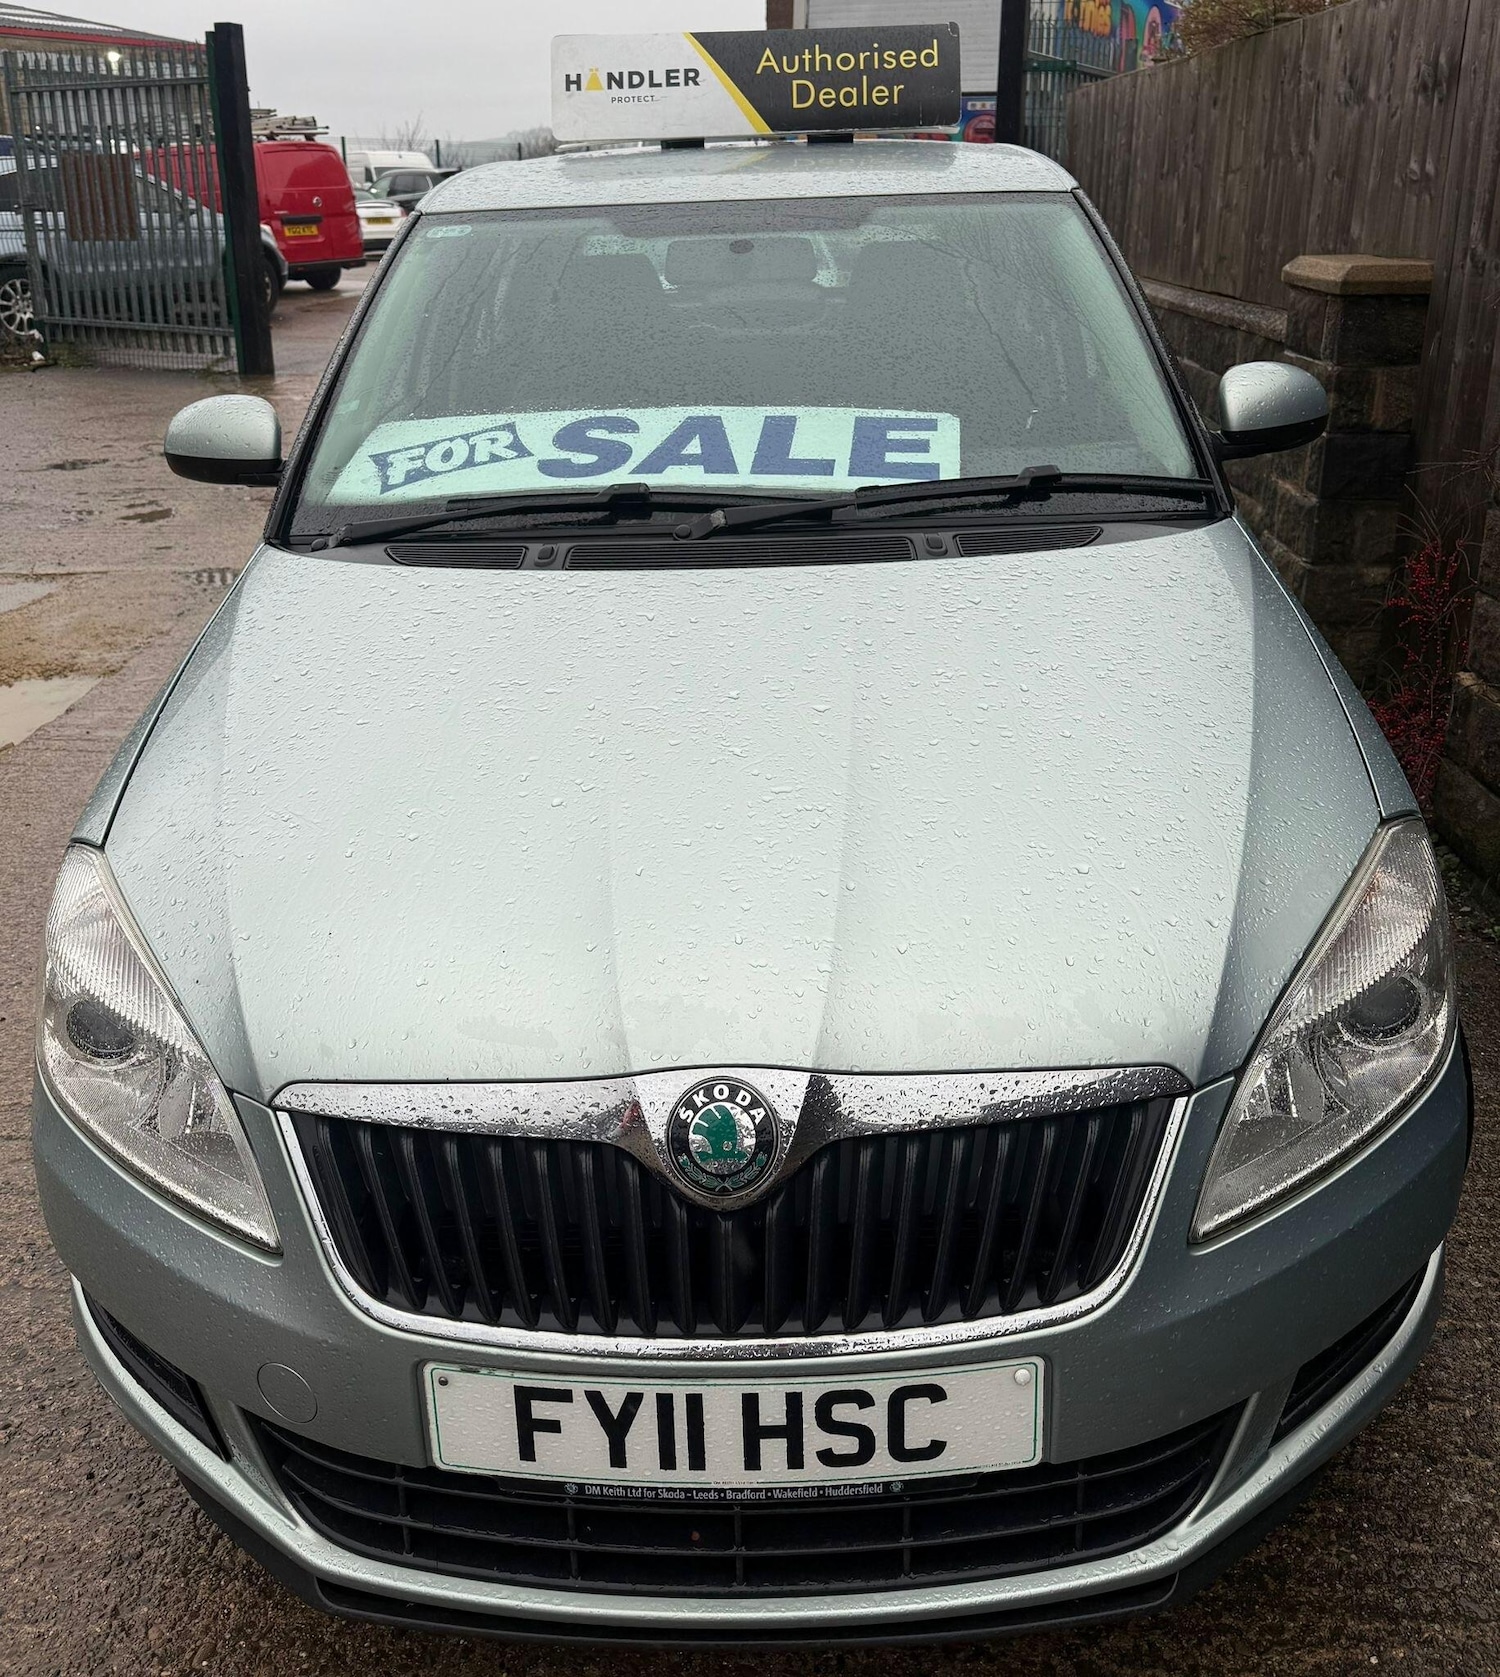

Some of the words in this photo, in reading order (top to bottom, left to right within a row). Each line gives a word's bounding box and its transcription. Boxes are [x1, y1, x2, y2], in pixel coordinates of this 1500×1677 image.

[755, 38, 939, 75] Authorised
[611, 95, 656, 104] PROTECT
[791, 75, 905, 109] Dealer
[386, 430, 519, 485] FOR
[537, 415, 941, 481] SALE
[513, 1384, 706, 1471] FY11
[741, 1383, 948, 1471] HSC
[585, 1484, 601, 1495] DM
[602, 1485, 625, 1497] Keith
[627, 1487, 642, 1498] Ltd
[643, 1487, 656, 1498] for
[657, 1488, 685, 1499] Skoda
[693, 1489, 719, 1500] Leeds
[726, 1488, 766, 1500] Bradford
[773, 1486, 818, 1499] Wakefield
[825, 1483, 883, 1497] Huddersfield
